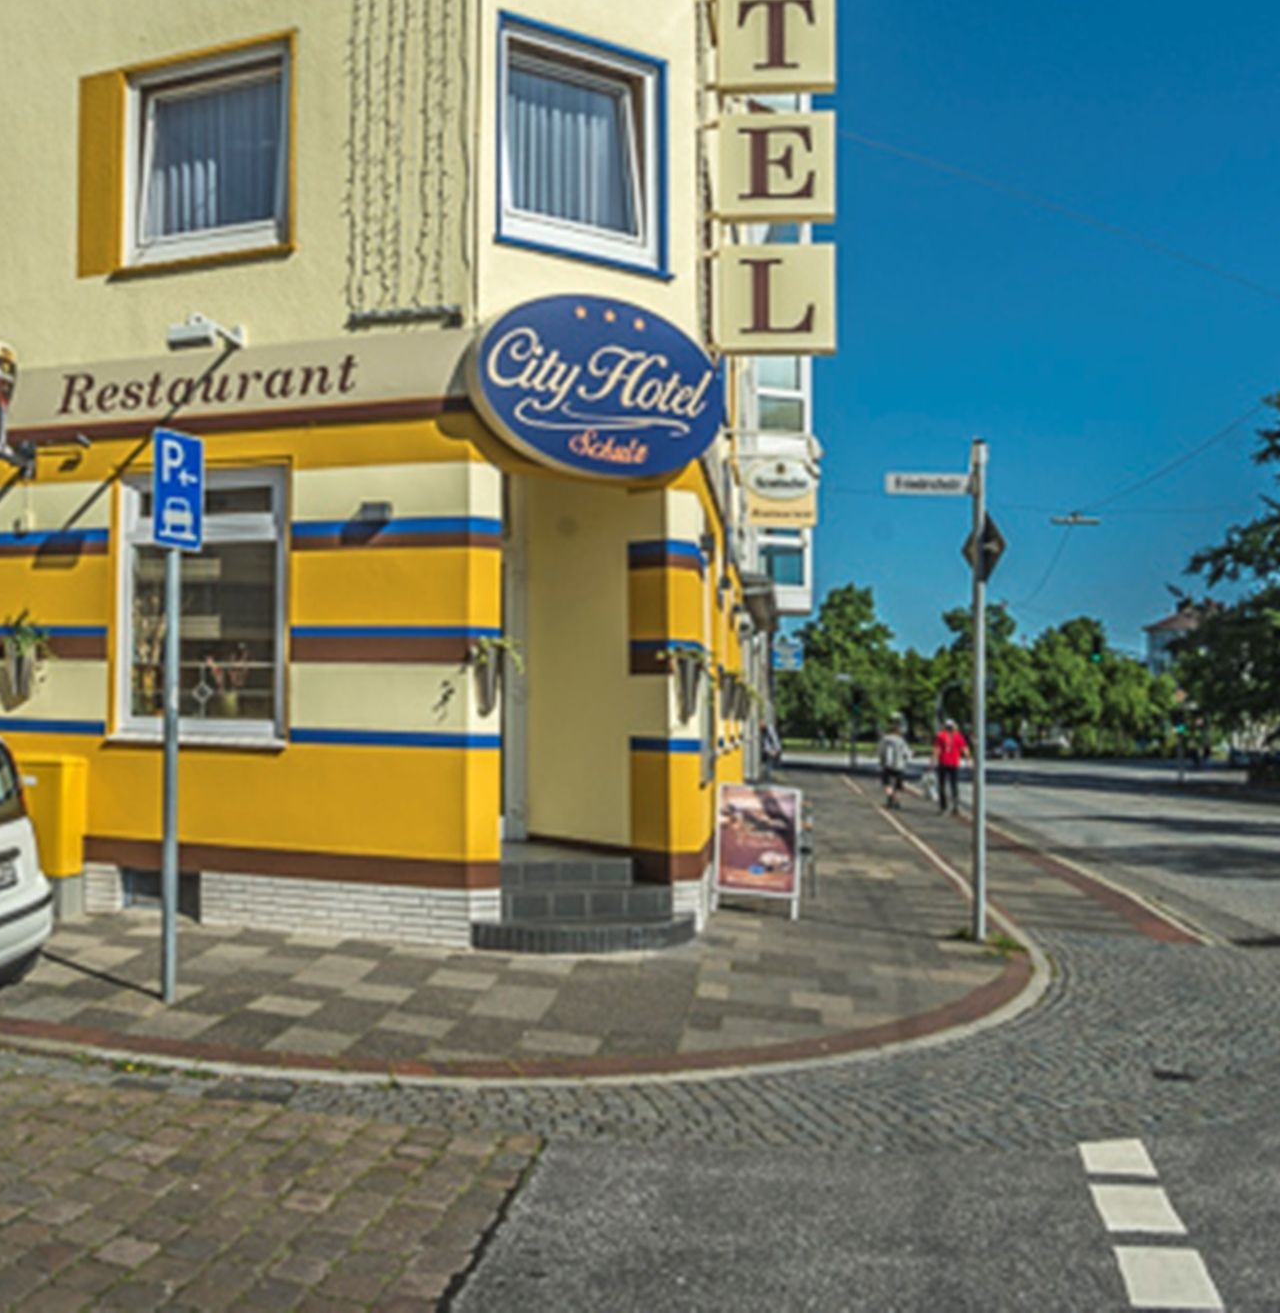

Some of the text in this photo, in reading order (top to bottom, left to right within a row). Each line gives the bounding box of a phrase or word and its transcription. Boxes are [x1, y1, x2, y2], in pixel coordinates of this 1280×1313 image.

[57, 354, 358, 415] Restaurant
[487, 327, 713, 417] City Hotel
[162, 439, 184, 483] P
